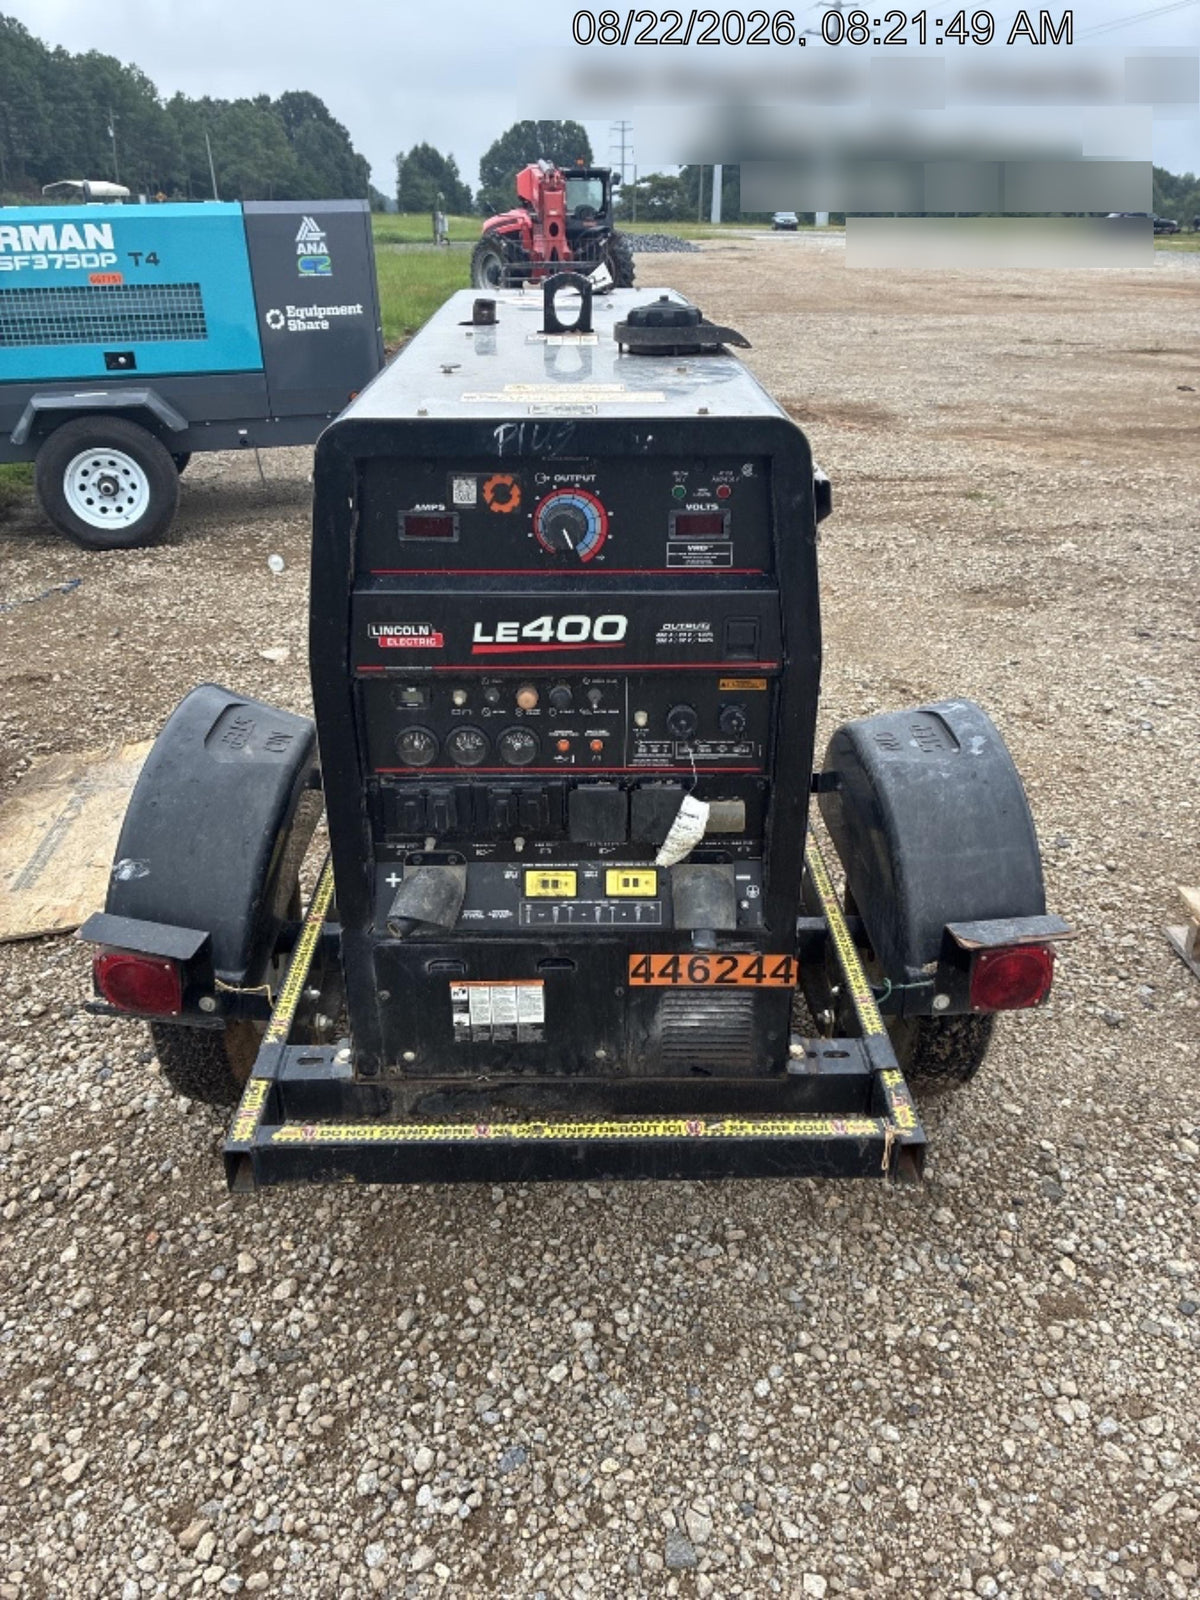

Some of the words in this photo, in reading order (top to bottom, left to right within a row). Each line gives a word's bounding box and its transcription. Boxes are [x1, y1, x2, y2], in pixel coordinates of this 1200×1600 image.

[296, 242, 329, 255] ANA
[127, 252, 160, 266] T4
[286, 304, 363, 319] Equipment
[288, 319, 330, 331] Share
[554, 474, 597, 482] OUTPUT
[414, 503, 445, 511] AMPS
[685, 503, 719, 511] VOLTS
[371, 625, 431, 636] LINCOLN
[472, 614, 628, 643] LE400
[386, 637, 437, 647] ELECTRIC
[631, 955, 794, 984] 446244
